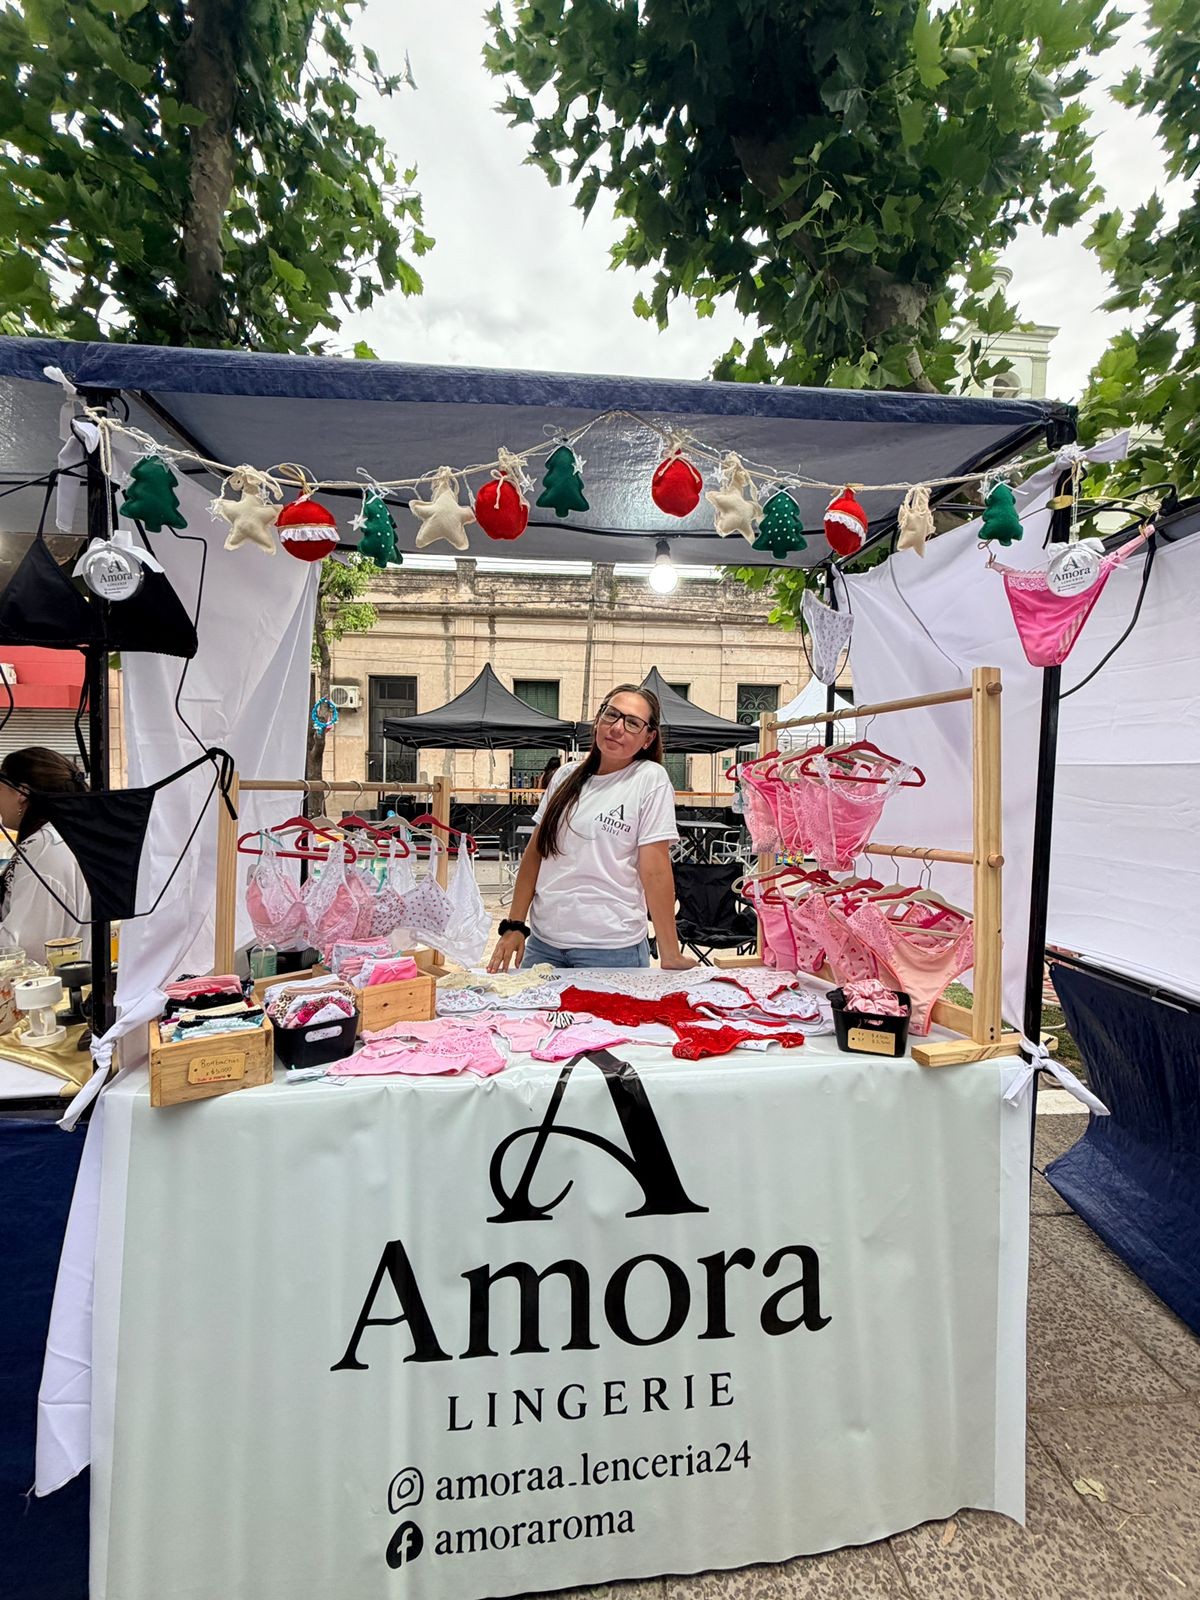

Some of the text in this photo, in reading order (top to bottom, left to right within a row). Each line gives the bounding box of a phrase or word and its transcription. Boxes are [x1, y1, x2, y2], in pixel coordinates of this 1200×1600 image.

[1062, 556, 1080, 572] A
[100, 572, 133, 583] Amora
[1053, 567, 1091, 583] Amora
[594, 812, 632, 833] Amora
[609, 803, 625, 821] A
[601, 824, 620, 836] Silvi
[487, 1048, 709, 1224] A
[330, 1240, 832, 1371] Amora
[448, 1372, 733, 1431] LINGERIE
[435, 1439, 752, 1501] amoraa_lenceria24
[434, 1509, 636, 1556] amoraroma
